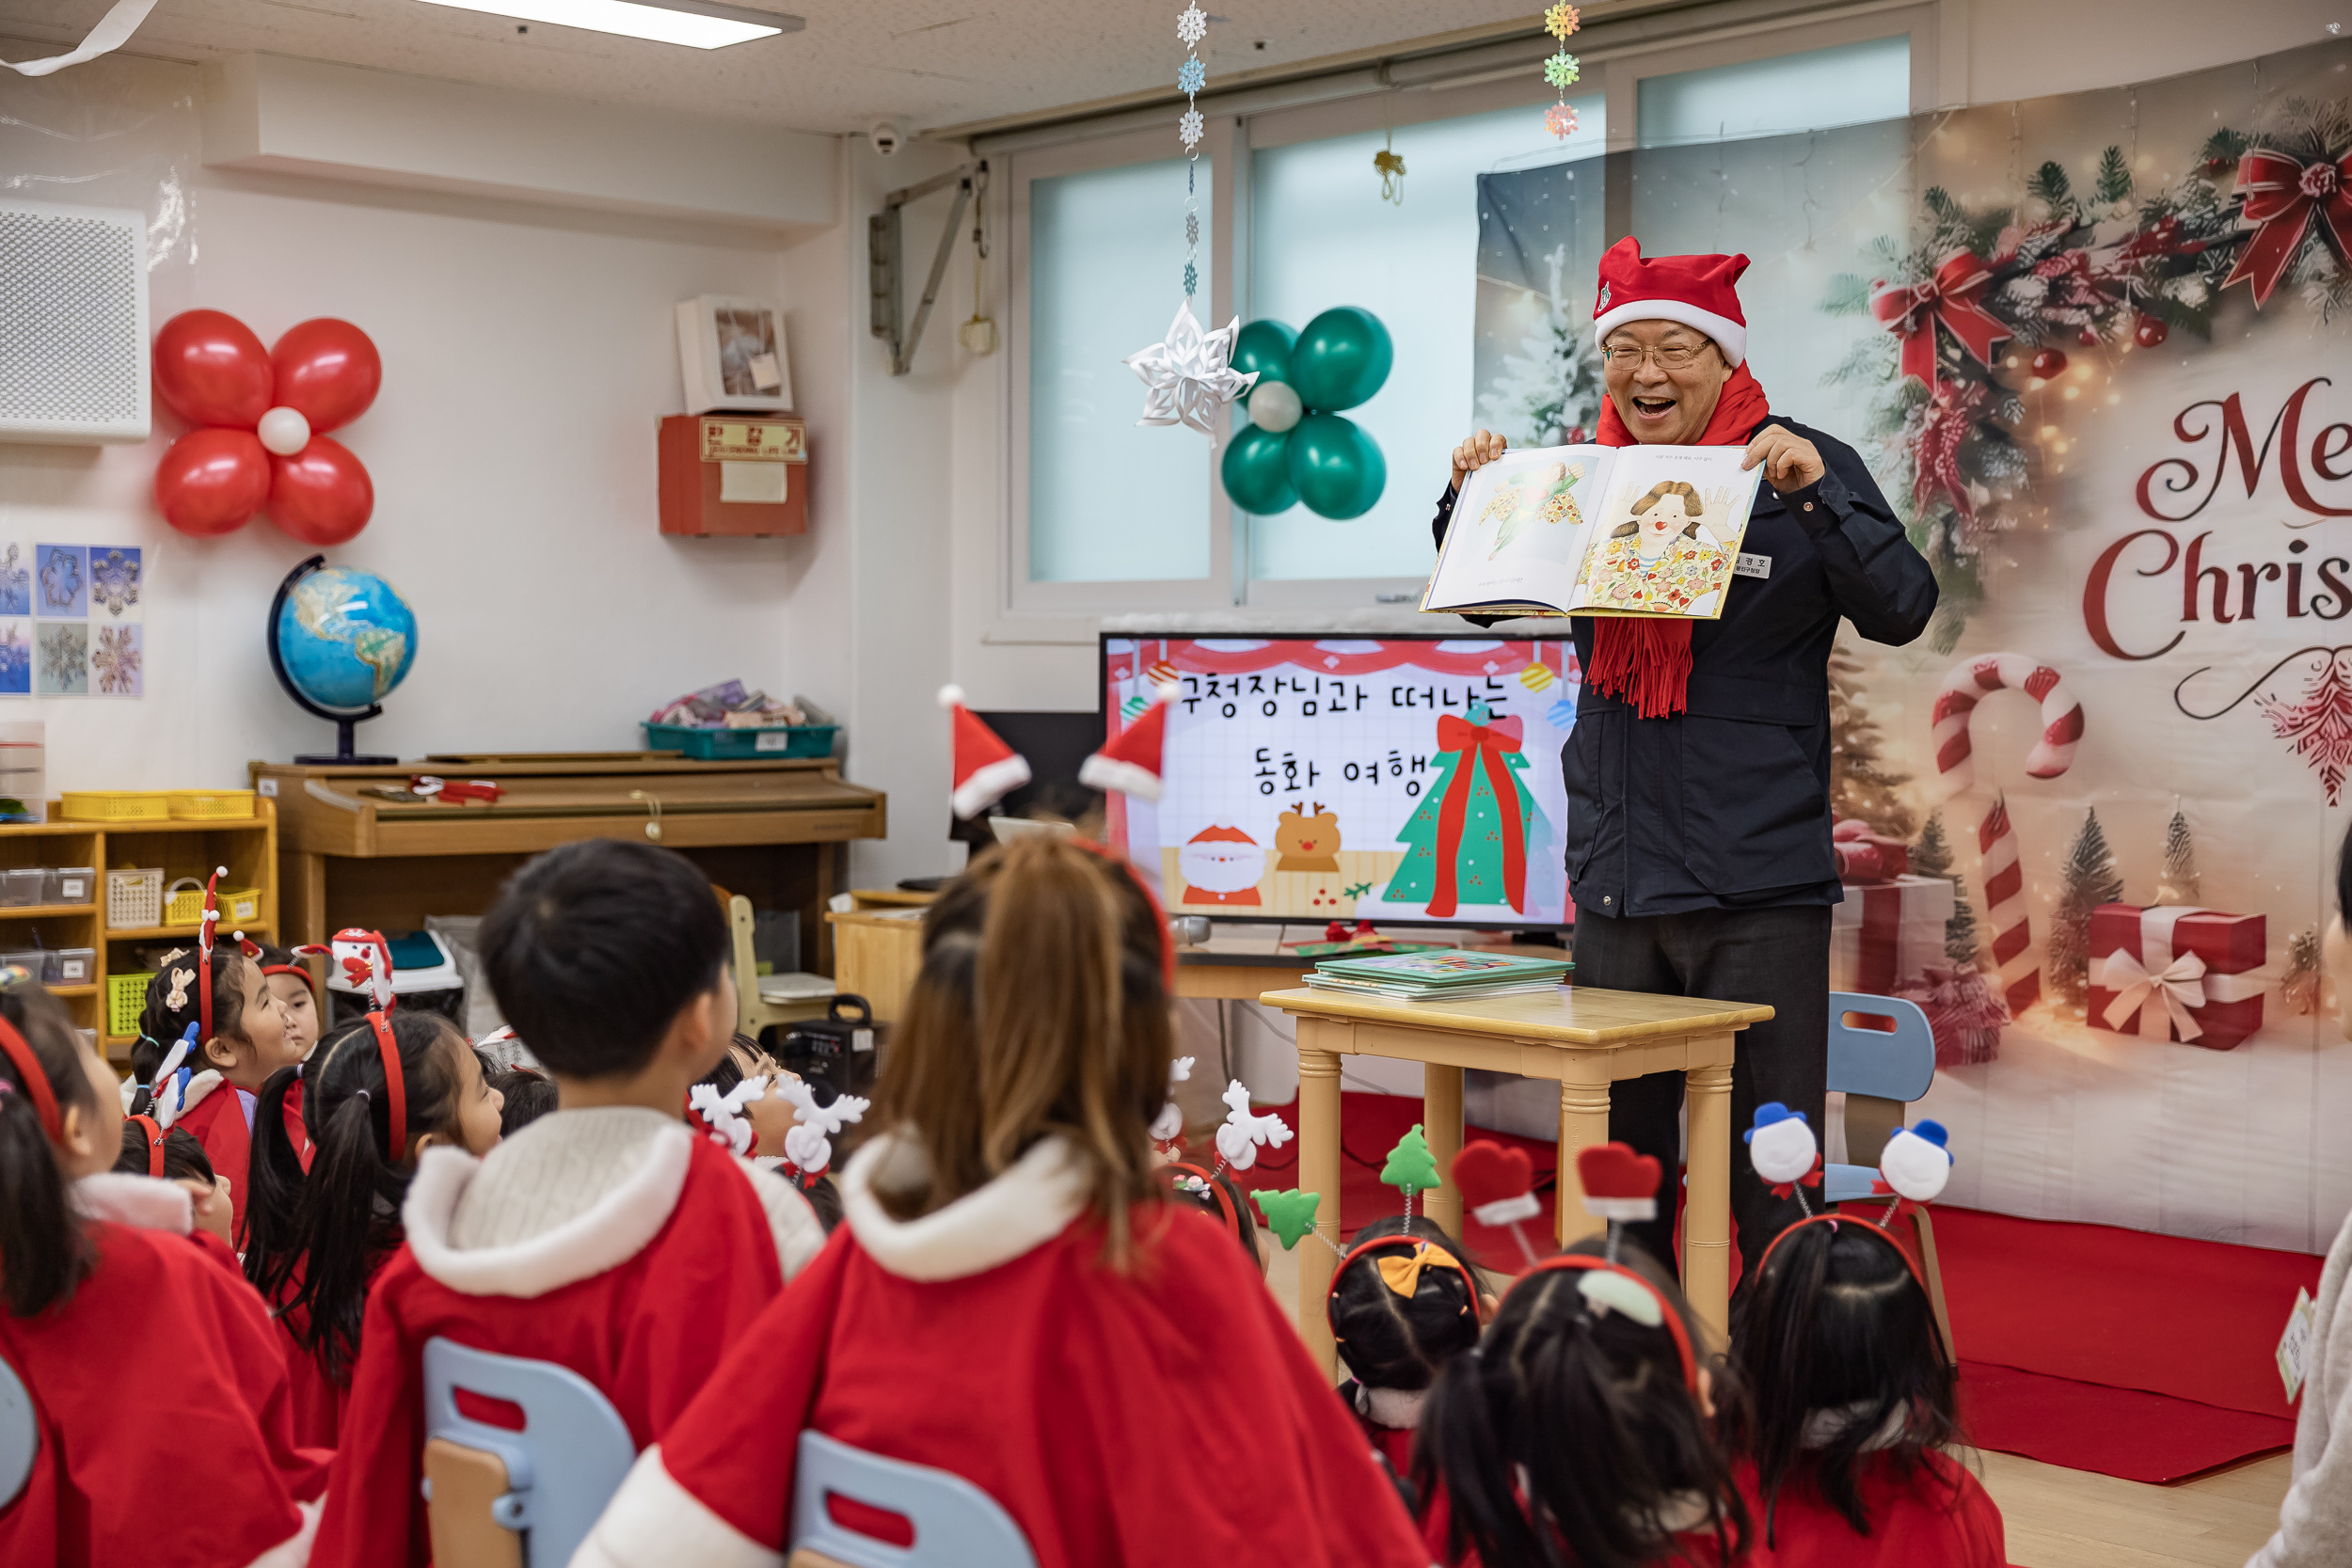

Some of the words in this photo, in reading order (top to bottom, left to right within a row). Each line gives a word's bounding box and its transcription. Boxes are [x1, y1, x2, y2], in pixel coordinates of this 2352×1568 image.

[1182, 672, 1368, 718] 구청장님과
[1391, 675, 1508, 720] 떠나는
[1255, 748, 1320, 796] 동화
[1343, 751, 1426, 797] 여행
